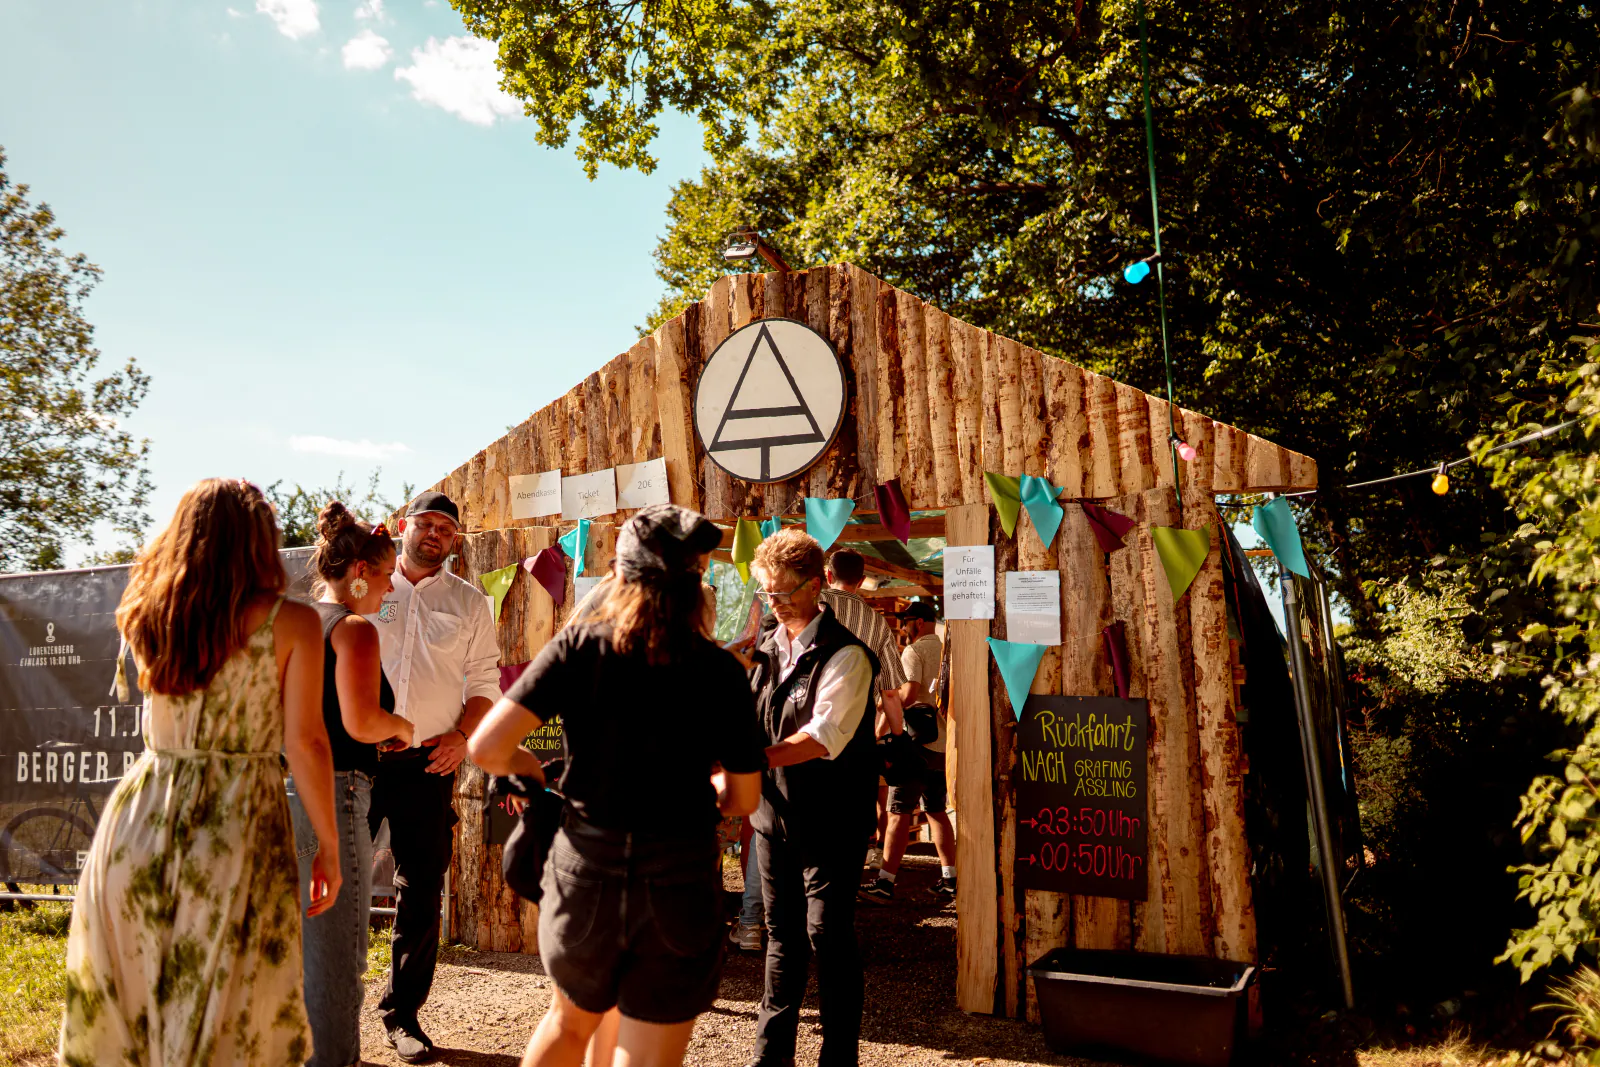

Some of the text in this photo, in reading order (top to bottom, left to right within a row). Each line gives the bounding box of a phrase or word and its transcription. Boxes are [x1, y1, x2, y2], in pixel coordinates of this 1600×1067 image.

[637, 479, 653, 490] 20€
[516, 488, 557, 500] Abendkasse
[577, 489, 600, 500] Ticket
[962, 555, 975, 563] Für
[955, 567, 982, 576] Unfälle
[950, 579, 987, 588] wird nicht
[952, 592, 986, 601] gehaftet!
[29, 644, 74, 656] LORENZENBERG
[20, 657, 47, 667] EINLASS
[68, 655, 81, 665] UHR
[93, 707, 140, 738] 11.J
[1034, 710, 1137, 751] Rückfahrt
[523, 739, 562, 750] ASSLING
[17, 751, 109, 783] BERGER
[1022, 750, 1132, 784] NACH GRAFING
[1073, 778, 1137, 798] ASSLING
[1038, 806, 1141, 838] 23:50 Uhr
[1040, 842, 1143, 880] 00:50 Uhr
